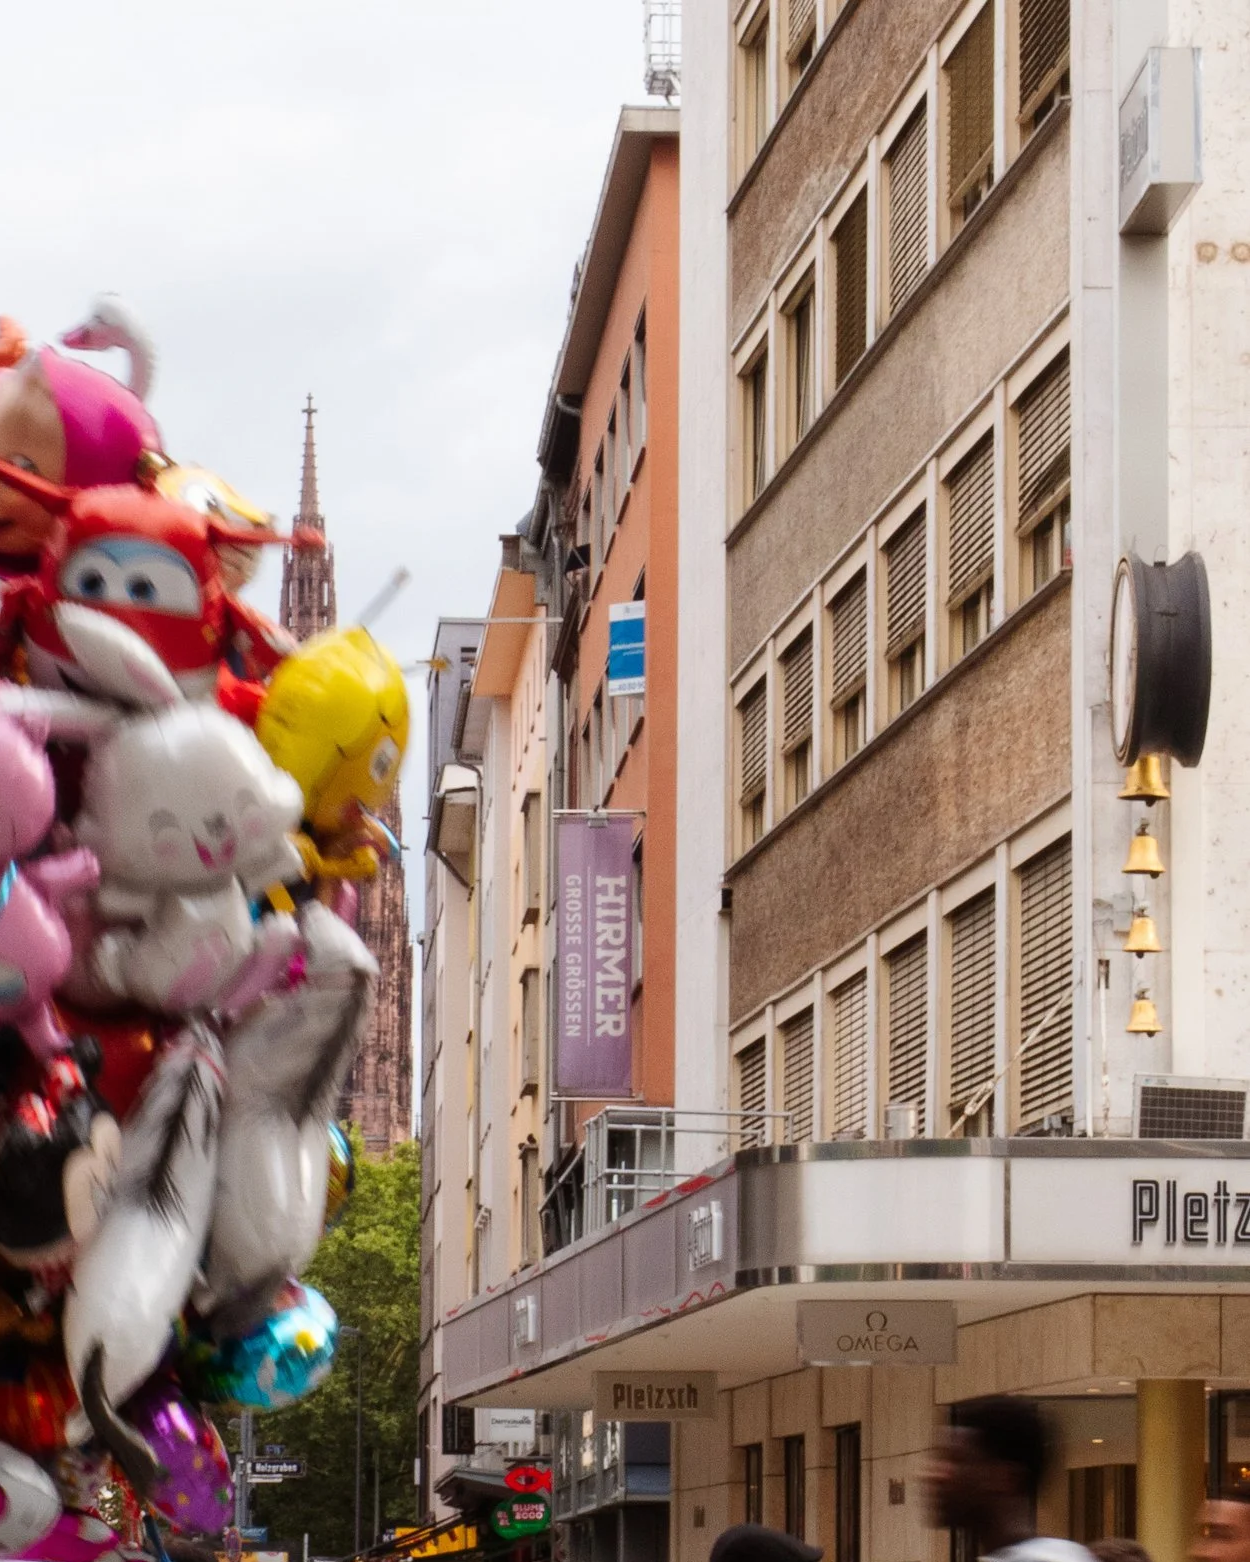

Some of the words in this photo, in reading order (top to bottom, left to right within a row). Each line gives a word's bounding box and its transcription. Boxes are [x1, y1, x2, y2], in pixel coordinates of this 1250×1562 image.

[565, 875, 582, 945] GROSSE
[596, 875, 626, 1037] HIRMER
[565, 953, 586, 1037] GRÖSSEN
[1133, 1180, 1250, 1242] Pletz
[837, 1334, 919, 1352] OMEGA
[612, 1383, 698, 1410] Pletzsch
[255, 1462, 298, 1473] Holzgraben
[512, 1503, 545, 1511] BLUME
[515, 1511, 543, 1520] 2000
